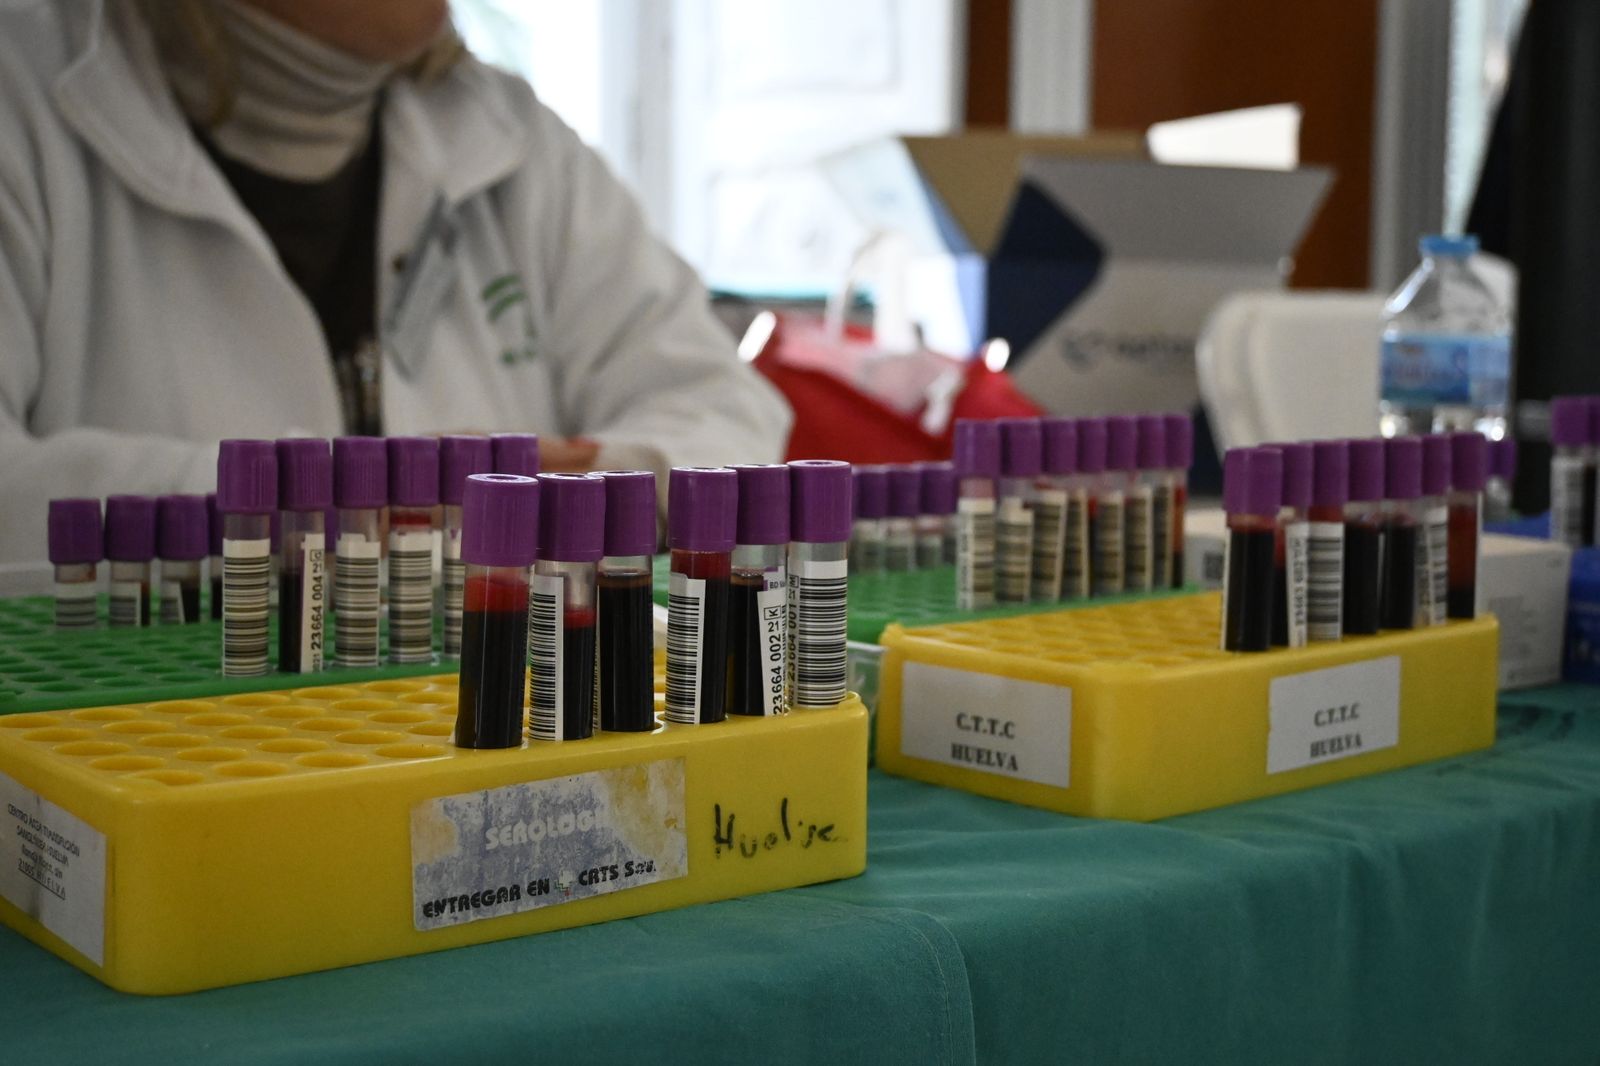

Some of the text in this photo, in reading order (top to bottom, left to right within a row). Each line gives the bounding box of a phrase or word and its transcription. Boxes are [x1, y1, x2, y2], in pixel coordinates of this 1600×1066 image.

[312, 576, 323, 600] 004
[311, 604, 322, 650] 23664
[788, 603, 798, 629] 001
[767, 608, 783, 715] 23664 002 21 K
[787, 633, 797, 682] 23664
[951, 742, 1018, 771] HUELVA
[1310, 732, 1362, 759] HUELVA
[422, 884, 521, 918] ENTREGAR
[527, 878, 550, 897] EN
[578, 864, 619, 886] CRTS
